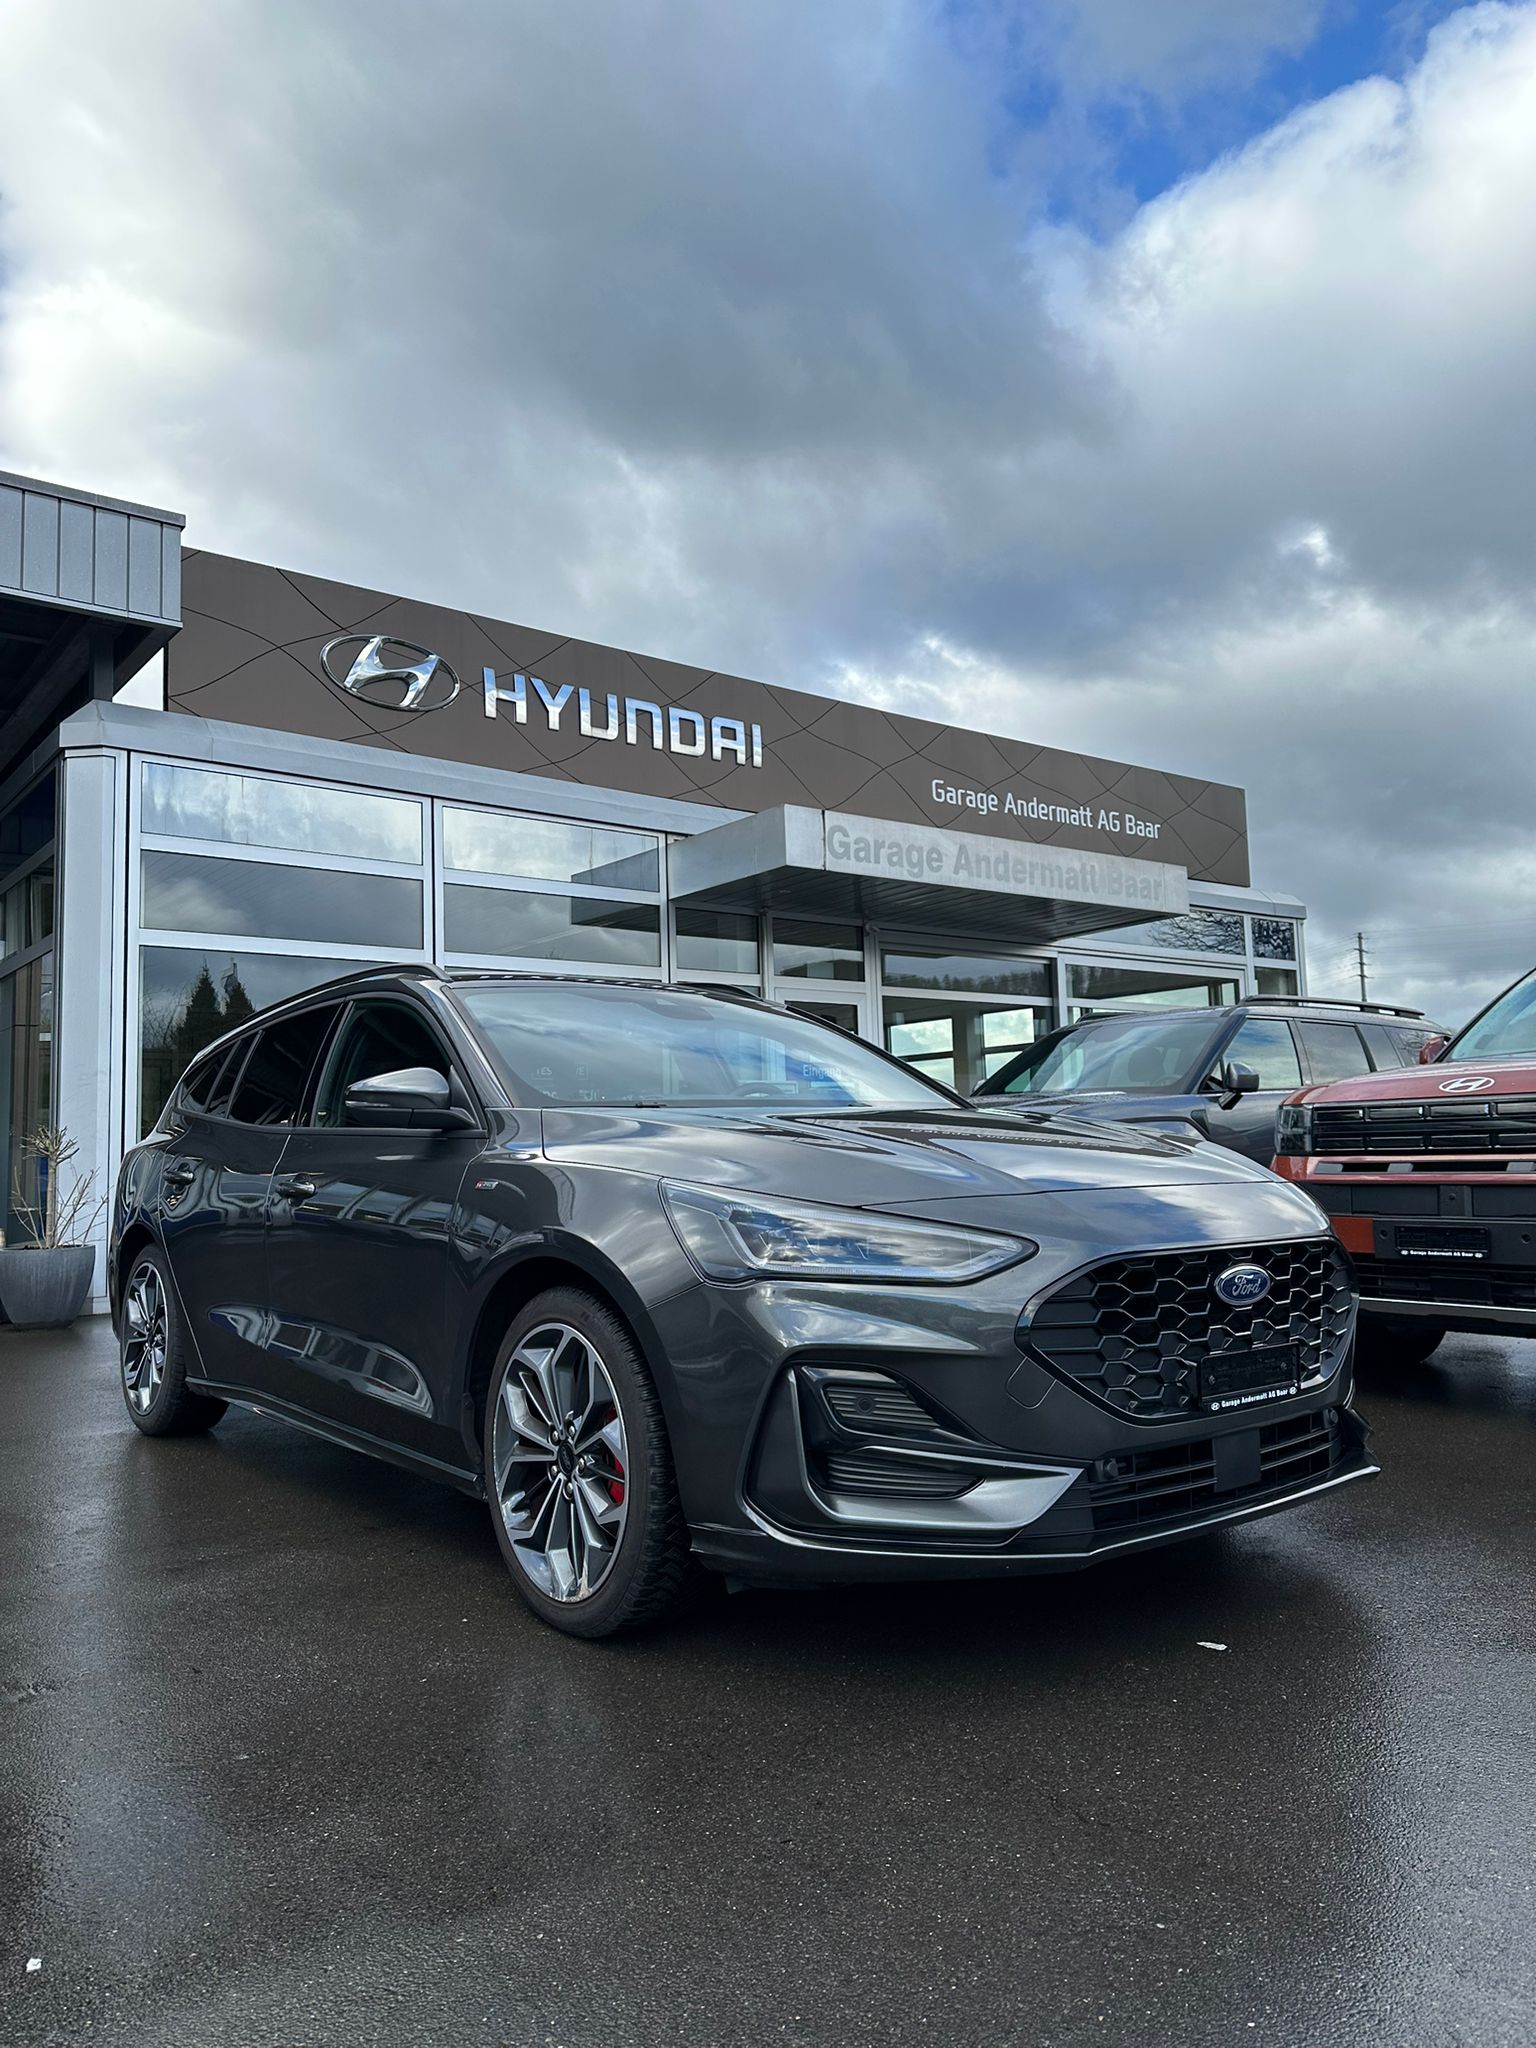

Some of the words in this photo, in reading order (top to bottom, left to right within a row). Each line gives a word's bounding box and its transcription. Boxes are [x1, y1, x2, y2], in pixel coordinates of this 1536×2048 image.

[482, 666, 763, 768] HYUNDAI
[931, 779, 998, 815] Garage
[1004, 792, 1093, 829] Andermatt
[1098, 809, 1121, 833] AG
[1125, 814, 1161, 840] Baar
[827, 824, 944, 879] Garage
[953, 843, 1099, 893] Andermatt
[1106, 868, 1163, 902] Baar
[1231, 1274, 1261, 1297] Ford
[1221, 1399, 1240, 1408] Garage
[1241, 1392, 1268, 1404] Andermatt
[1268, 1390, 1276, 1399] AG
[1276, 1388, 1288, 1397] Baar
